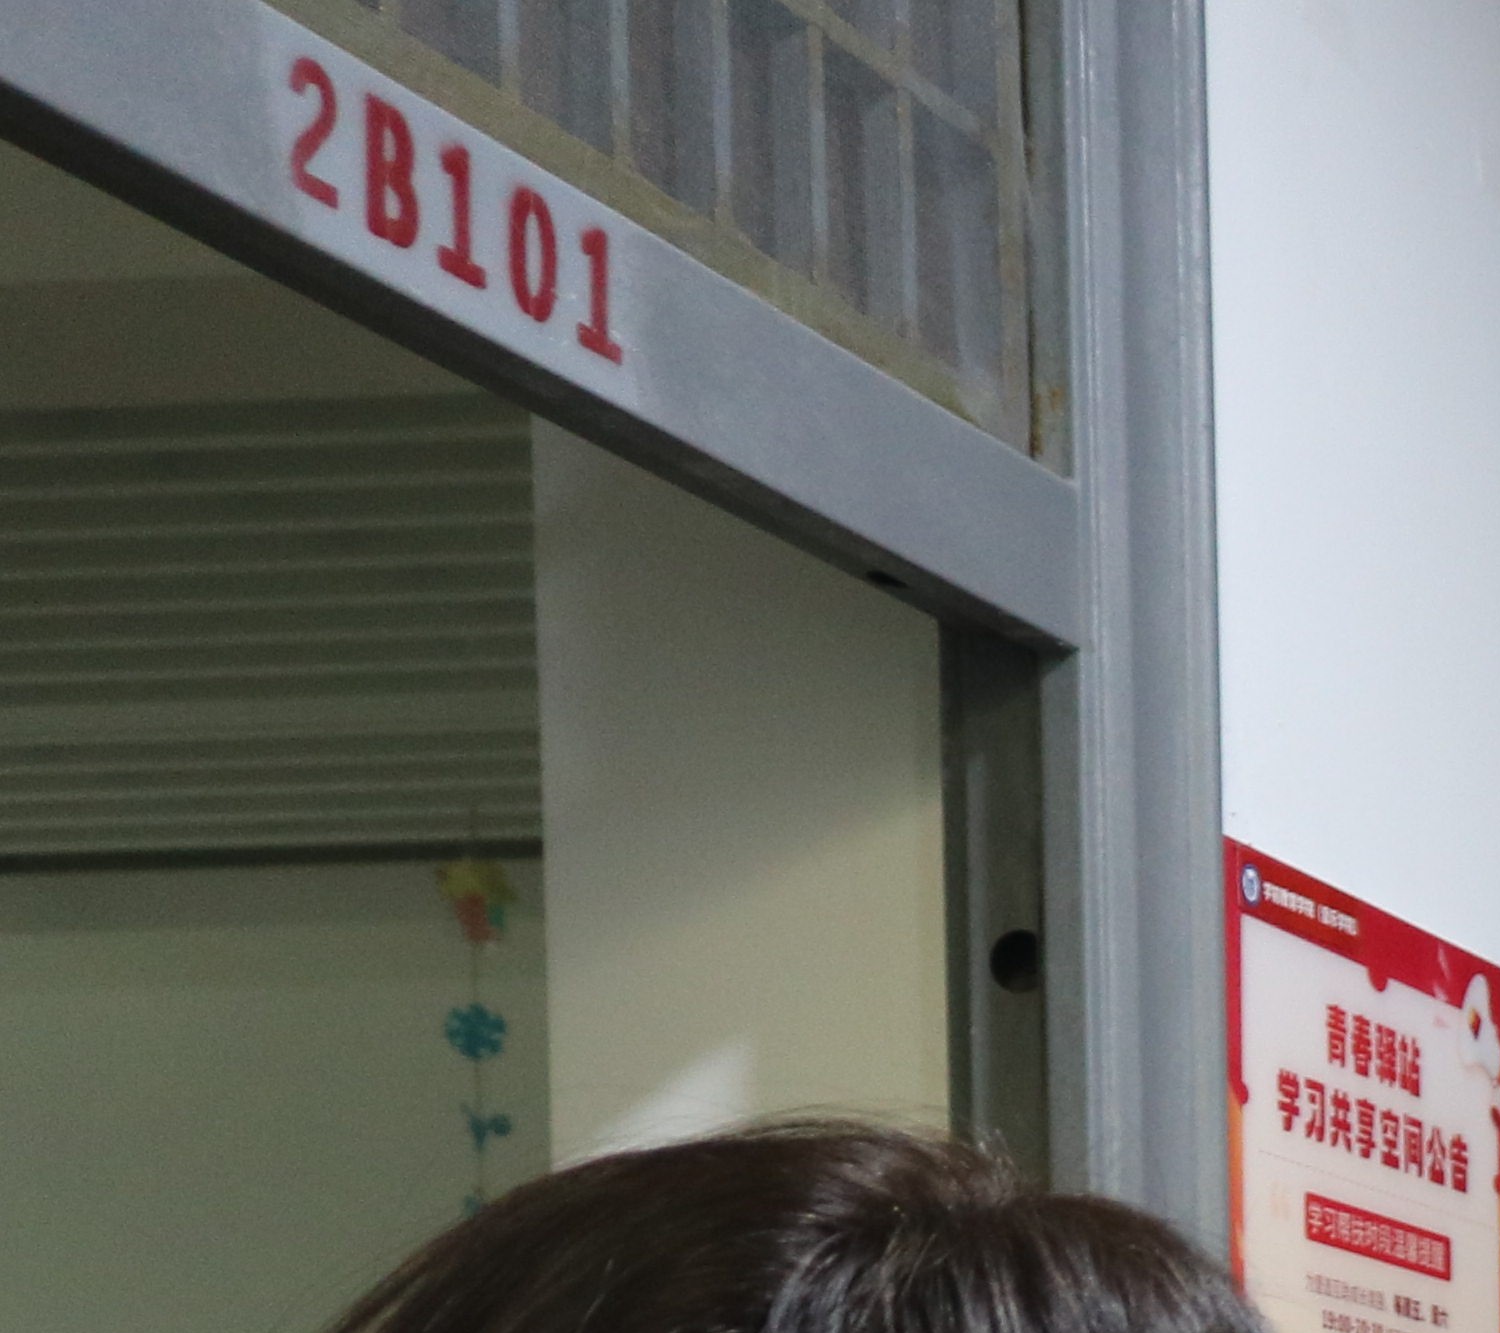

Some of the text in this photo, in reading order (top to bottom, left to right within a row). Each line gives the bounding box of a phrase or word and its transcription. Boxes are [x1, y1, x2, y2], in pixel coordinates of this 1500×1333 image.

[289, 56, 623, 365] 2B101
[1325, 1003, 1421, 1098] 青春驿站
[1276, 1068, 1468, 1193] 学习共享空间公告
